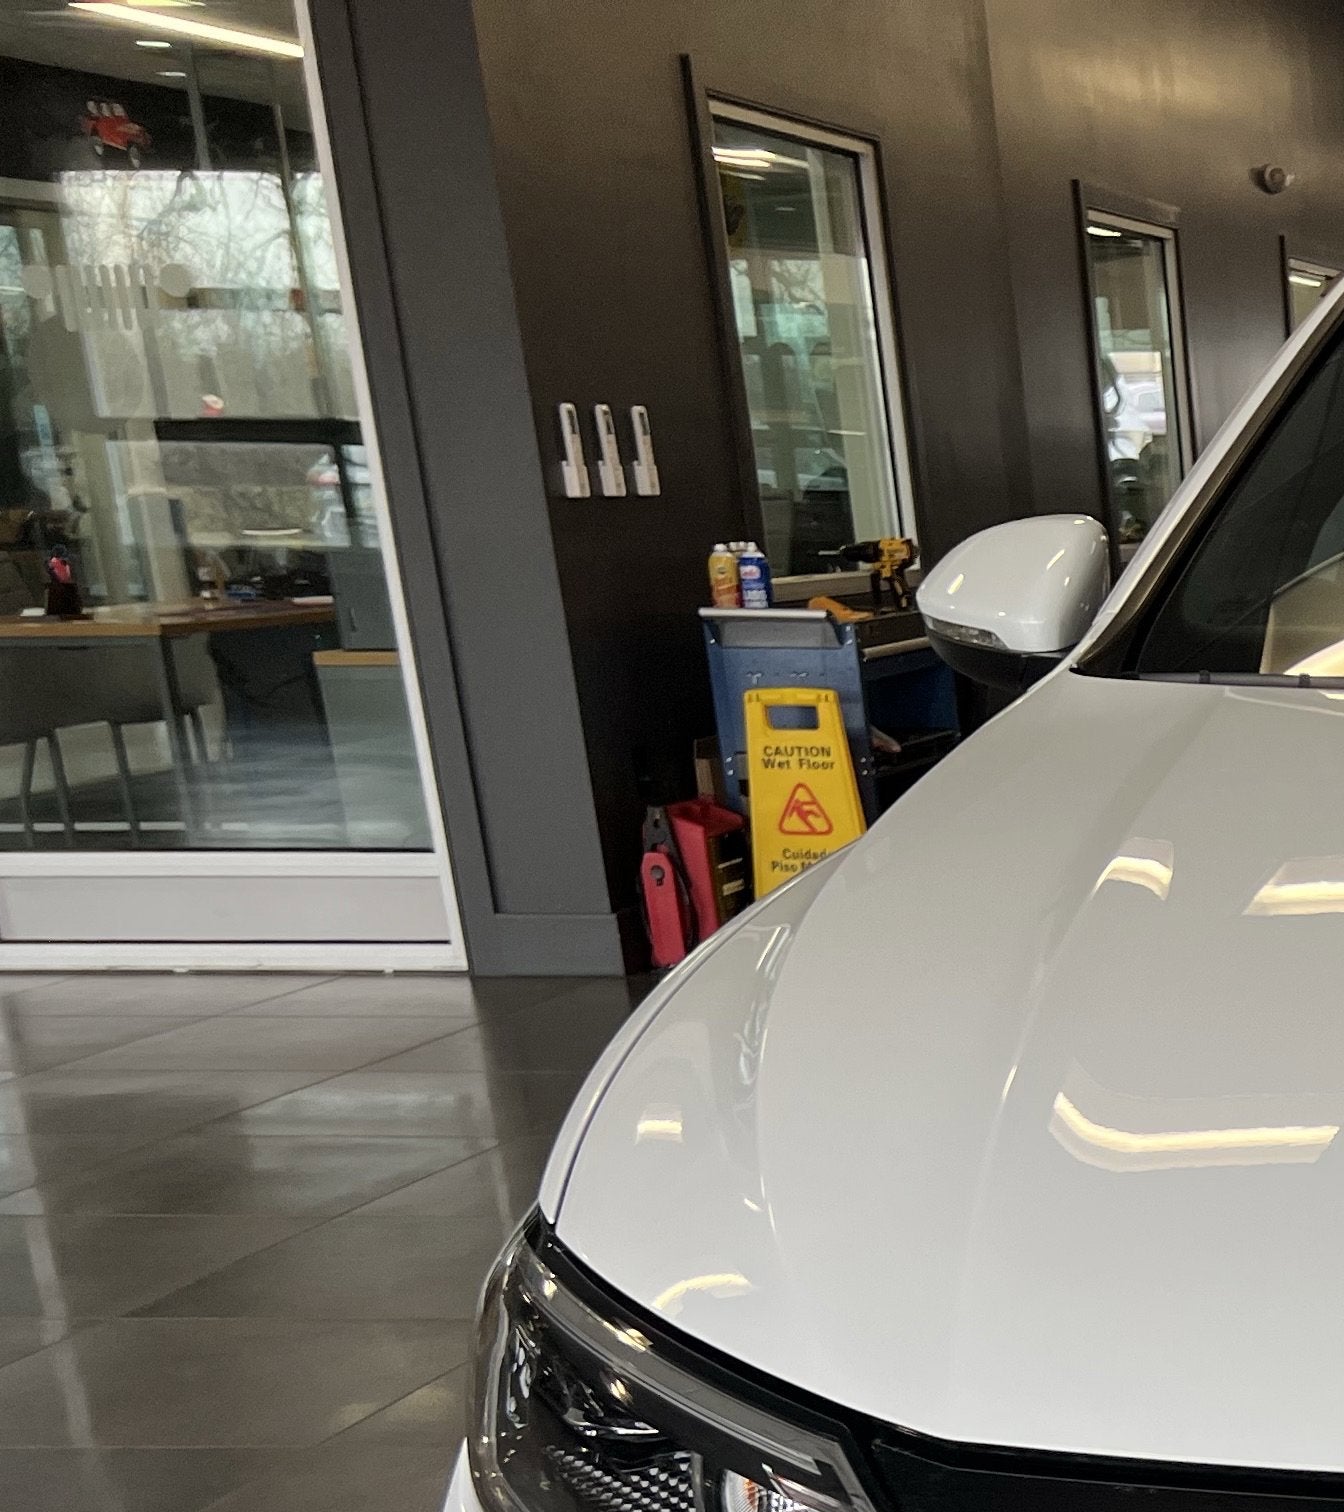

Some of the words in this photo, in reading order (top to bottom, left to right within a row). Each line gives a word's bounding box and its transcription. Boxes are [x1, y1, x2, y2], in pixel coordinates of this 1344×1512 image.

[763, 746, 831, 757] CAUTION
[762, 758, 791, 769] Wet
[798, 758, 835, 770] Floor
[782, 848, 828, 860] Cuidad
